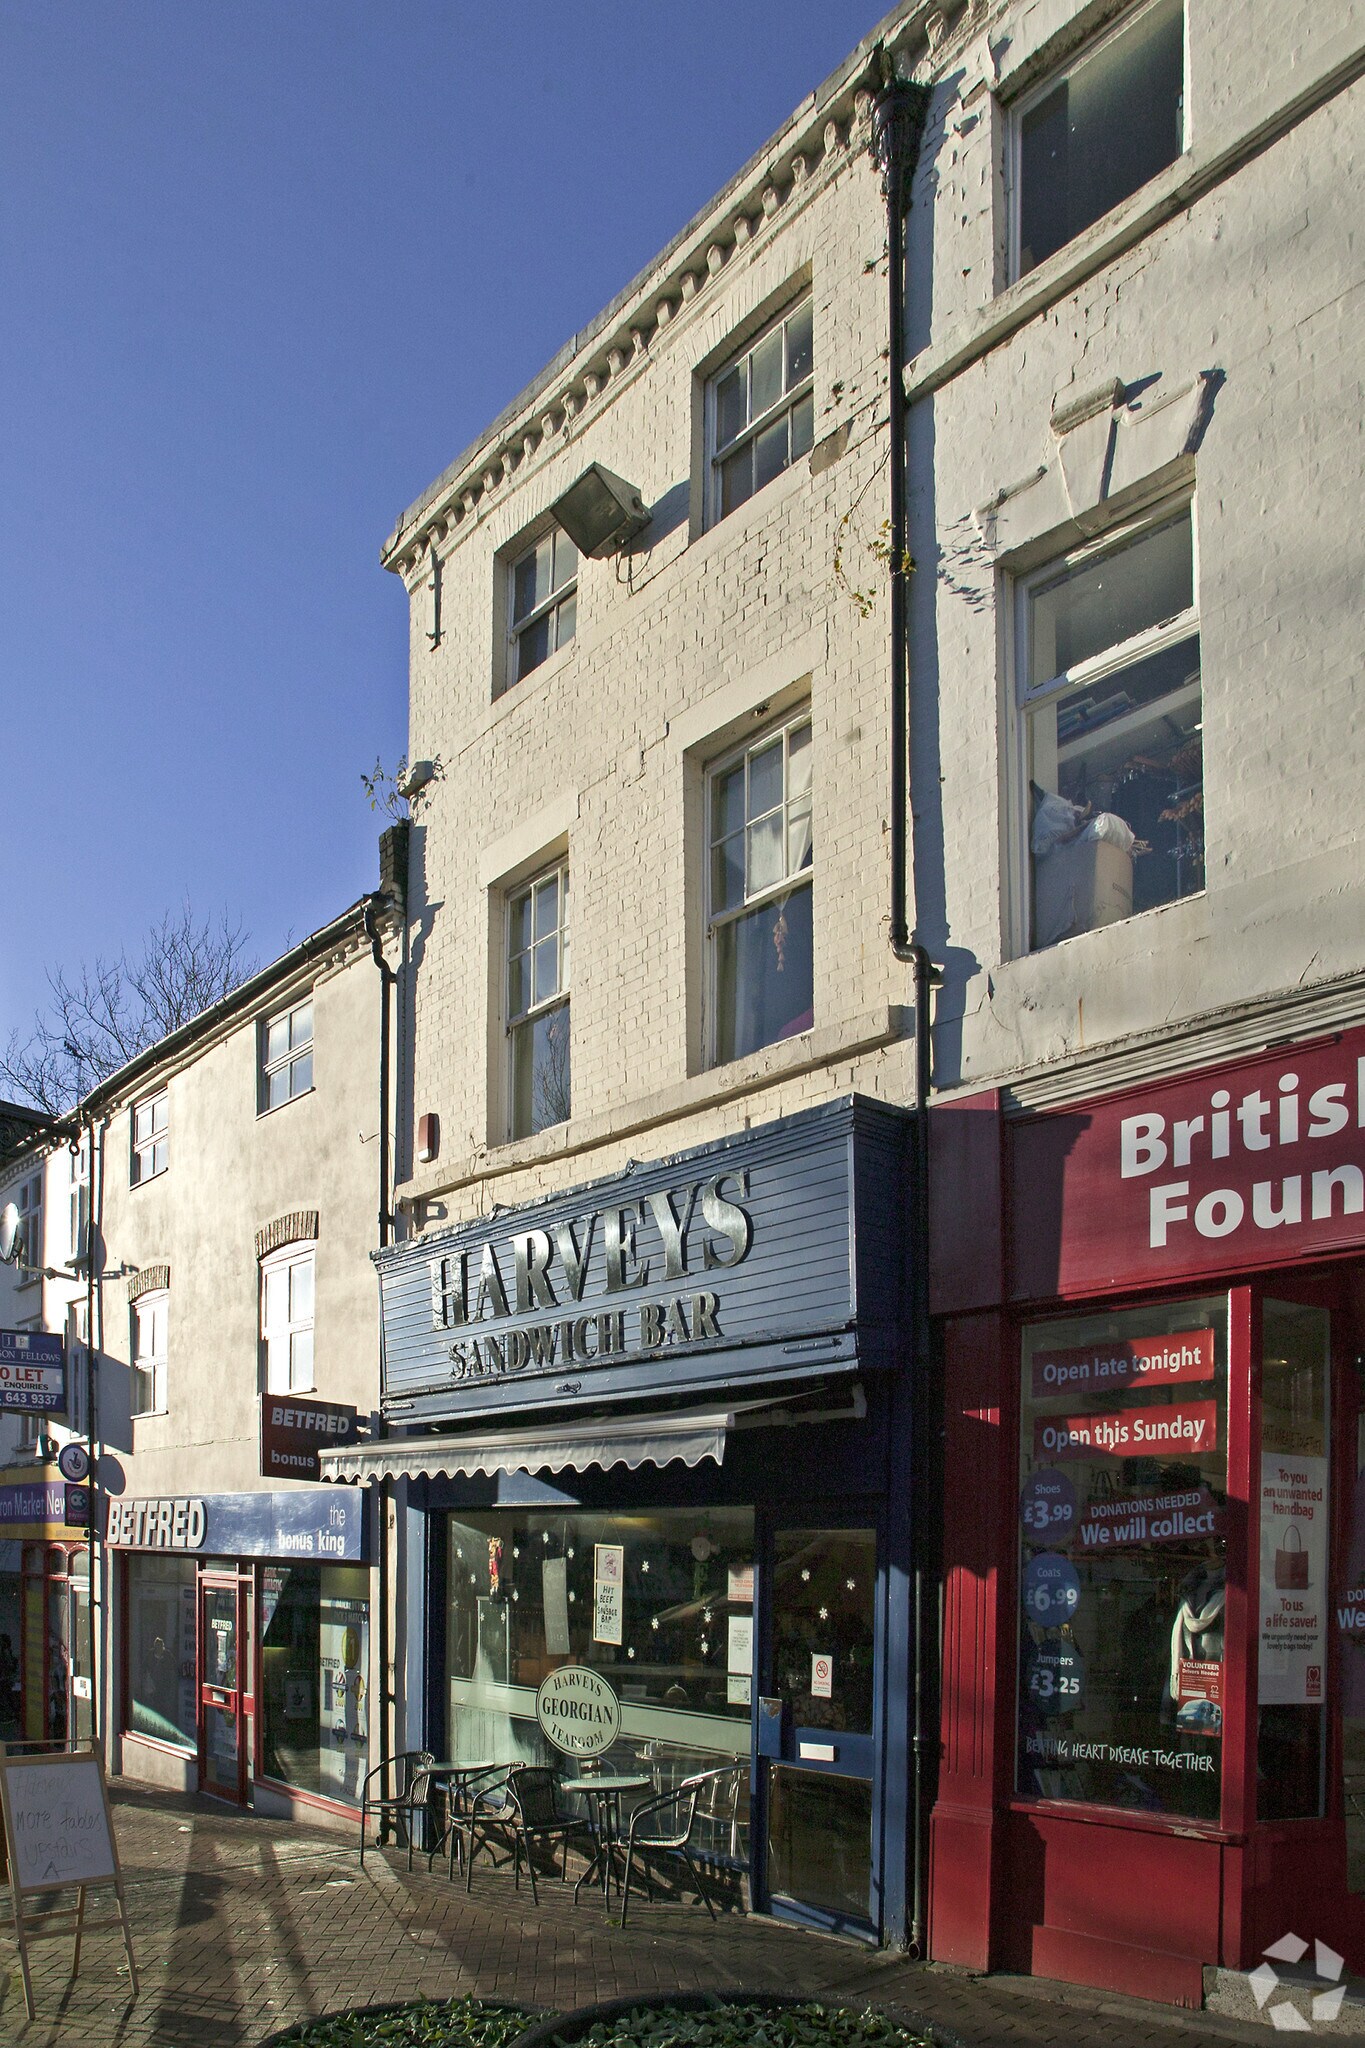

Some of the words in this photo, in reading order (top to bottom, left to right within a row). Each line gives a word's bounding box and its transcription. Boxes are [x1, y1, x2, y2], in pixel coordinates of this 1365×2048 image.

[1121, 1057, 1365, 1178] Britis
[1150, 1164, 1364, 1248] Foun
[427, 1168, 751, 1331] HARVEYS
[449, 1310, 628, 1379] SANDWICH
[639, 1291, 724, 1349] BAR
[21, 1352, 61, 1361] FELLOWS
[1043, 1364, 1090, 1385] Open
[1094, 1358, 1127, 1376] late
[1132, 1346, 1202, 1373] tonight
[4, 1382, 49, 1390] ENQUIRIES
[16, 1368, 44, 1382] LET
[5, 1392, 27, 1403] 643
[31, 1393, 58, 1405] 9337
[271, 1407, 350, 1434] BETFRED
[1042, 1426, 1090, 1450] Open
[1094, 1420, 1129, 1445] this
[1133, 1415, 1206, 1442] Sunday
[271, 1450, 315, 1467] bonus
[1035, 1484, 1061, 1495] Shoes
[1279, 1468, 1289, 1483] To
[1290, 1473, 1308, 1487] you
[14, 1491, 44, 1516] Market
[1091, 1498, 1154, 1519] DONATIONS
[1155, 1493, 1201, 1510] NEEDED
[1263, 1487, 1275, 1497] an
[1277, 1487, 1323, 1502] unwanted
[330, 1505, 346, 1526] the
[1024, 1501, 1073, 1529] £3.99
[1272, 1500, 1314, 1520] handbag
[107, 1500, 207, 1548] BETFRED
[1081, 1524, 1110, 1545] We
[1113, 1517, 1146, 1542] will
[1150, 1511, 1215, 1537] collect
[278, 1529, 313, 1551] bonus
[318, 1529, 345, 1556] king
[1026, 1583, 1078, 1611] £6.99
[1280, 1598, 1292, 1612] To
[1293, 1600, 1304, 1612] us
[211, 1618, 233, 1631] BETFRED
[1265, 1617, 1272, 1628] a
[1273, 1613, 1288, 1628] life
[1289, 1614, 1317, 1629] saver!
[1338, 1607, 1365, 1630] We
[1037, 1653, 1074, 1666] Jumpers
[1182, 1661, 1220, 1671] VOLUNTEER
[553, 1673, 602, 1697] HARVEYS
[1030, 1669, 1080, 1696] £3.25
[542, 1696, 613, 1725] GEORGIAN
[551, 1721, 604, 1749] TEAROOM
[1072, 1743, 1108, 1760] HEART
[1109, 1746, 1149, 1765] DISEASE
[1152, 1749, 1215, 1772] TOGETHER
